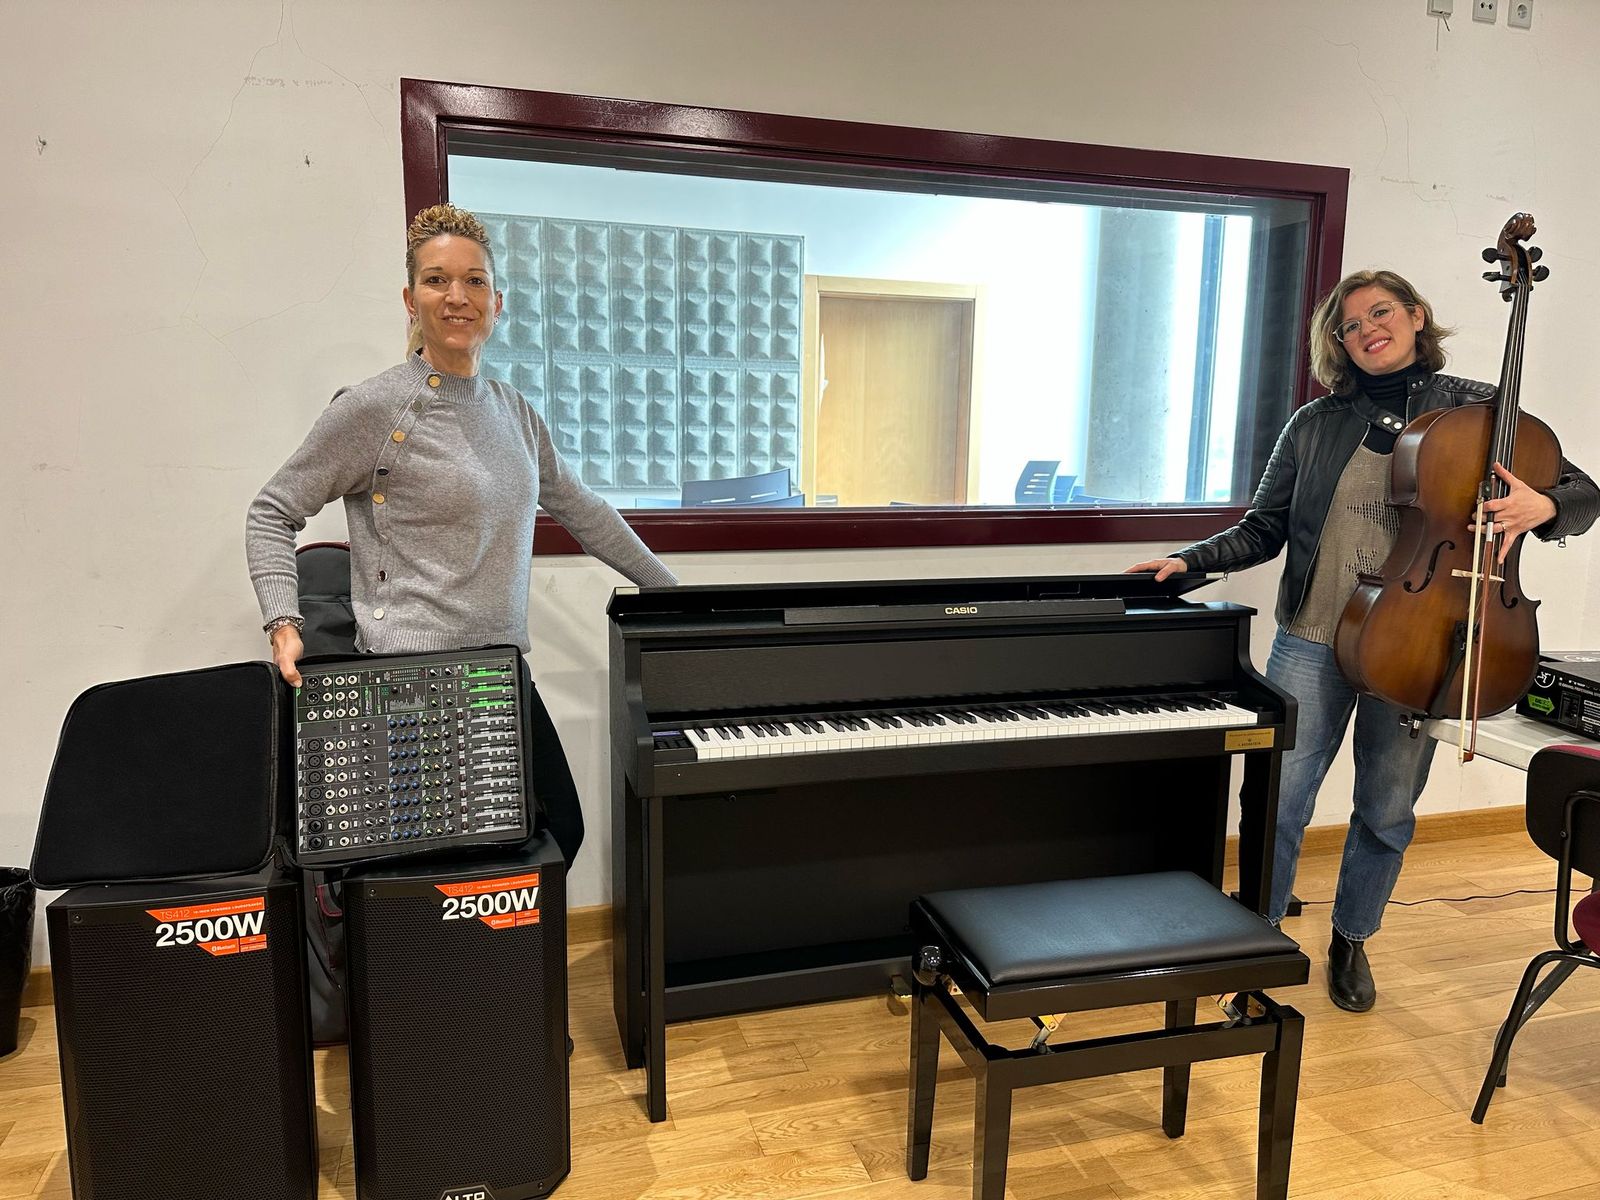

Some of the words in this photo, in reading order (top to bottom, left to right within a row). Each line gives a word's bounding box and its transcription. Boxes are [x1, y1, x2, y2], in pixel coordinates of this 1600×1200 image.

[945, 606, 978, 615] CASIO
[447, 885, 474, 894] TS412
[442, 887, 539, 920] 2500W
[160, 909, 190, 920] TS412
[155, 911, 265, 947] 2500W
